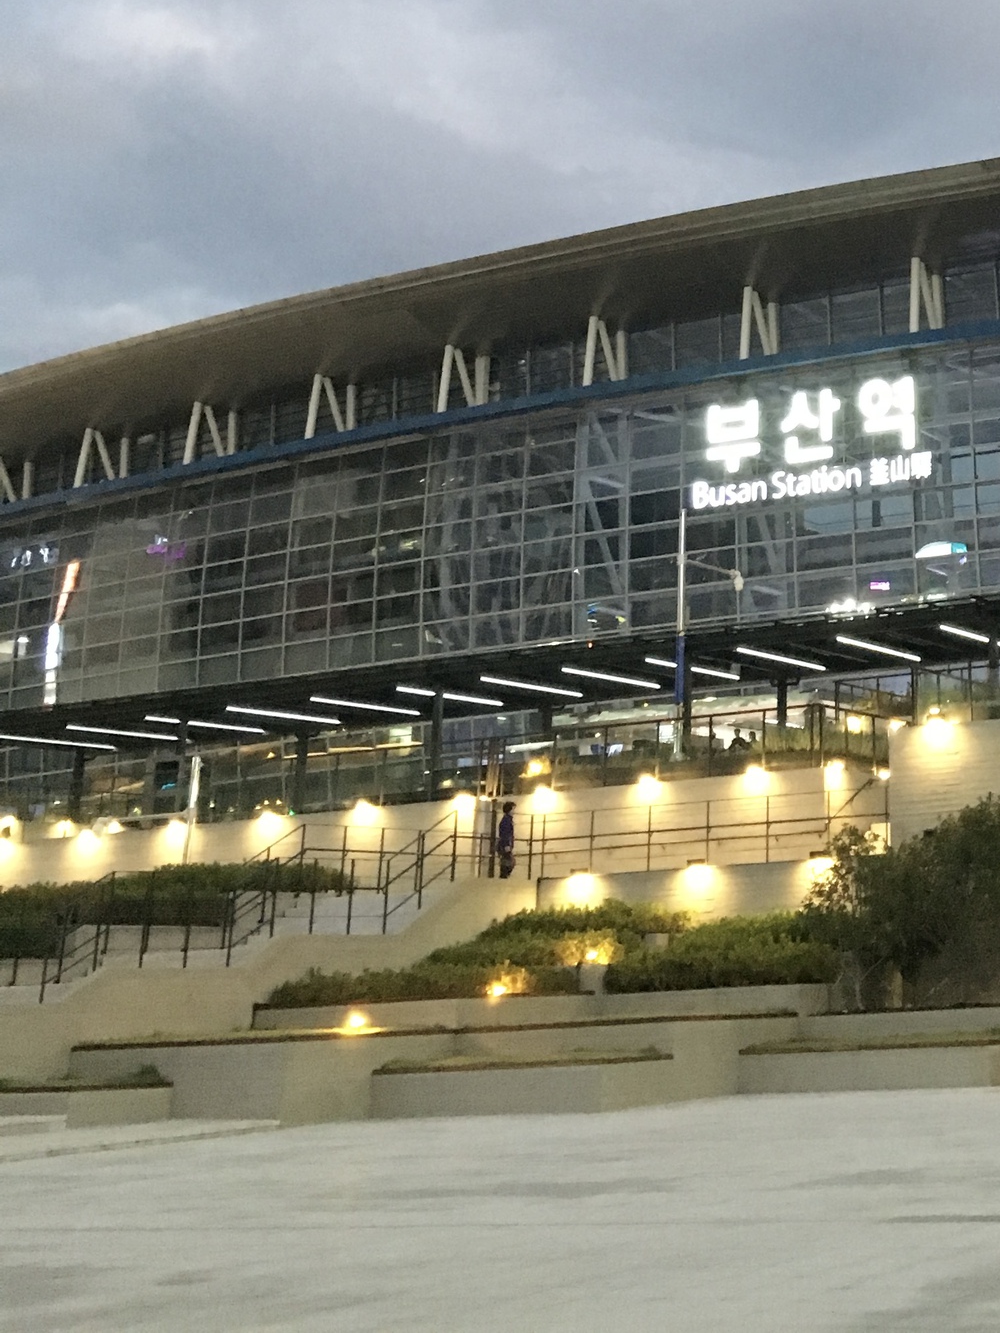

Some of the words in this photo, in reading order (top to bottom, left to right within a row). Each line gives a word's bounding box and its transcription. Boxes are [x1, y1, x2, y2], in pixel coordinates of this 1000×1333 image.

[706, 376, 916, 473] 부산역
[692, 481, 767, 510] Busan
[771, 466, 862, 499] Station
